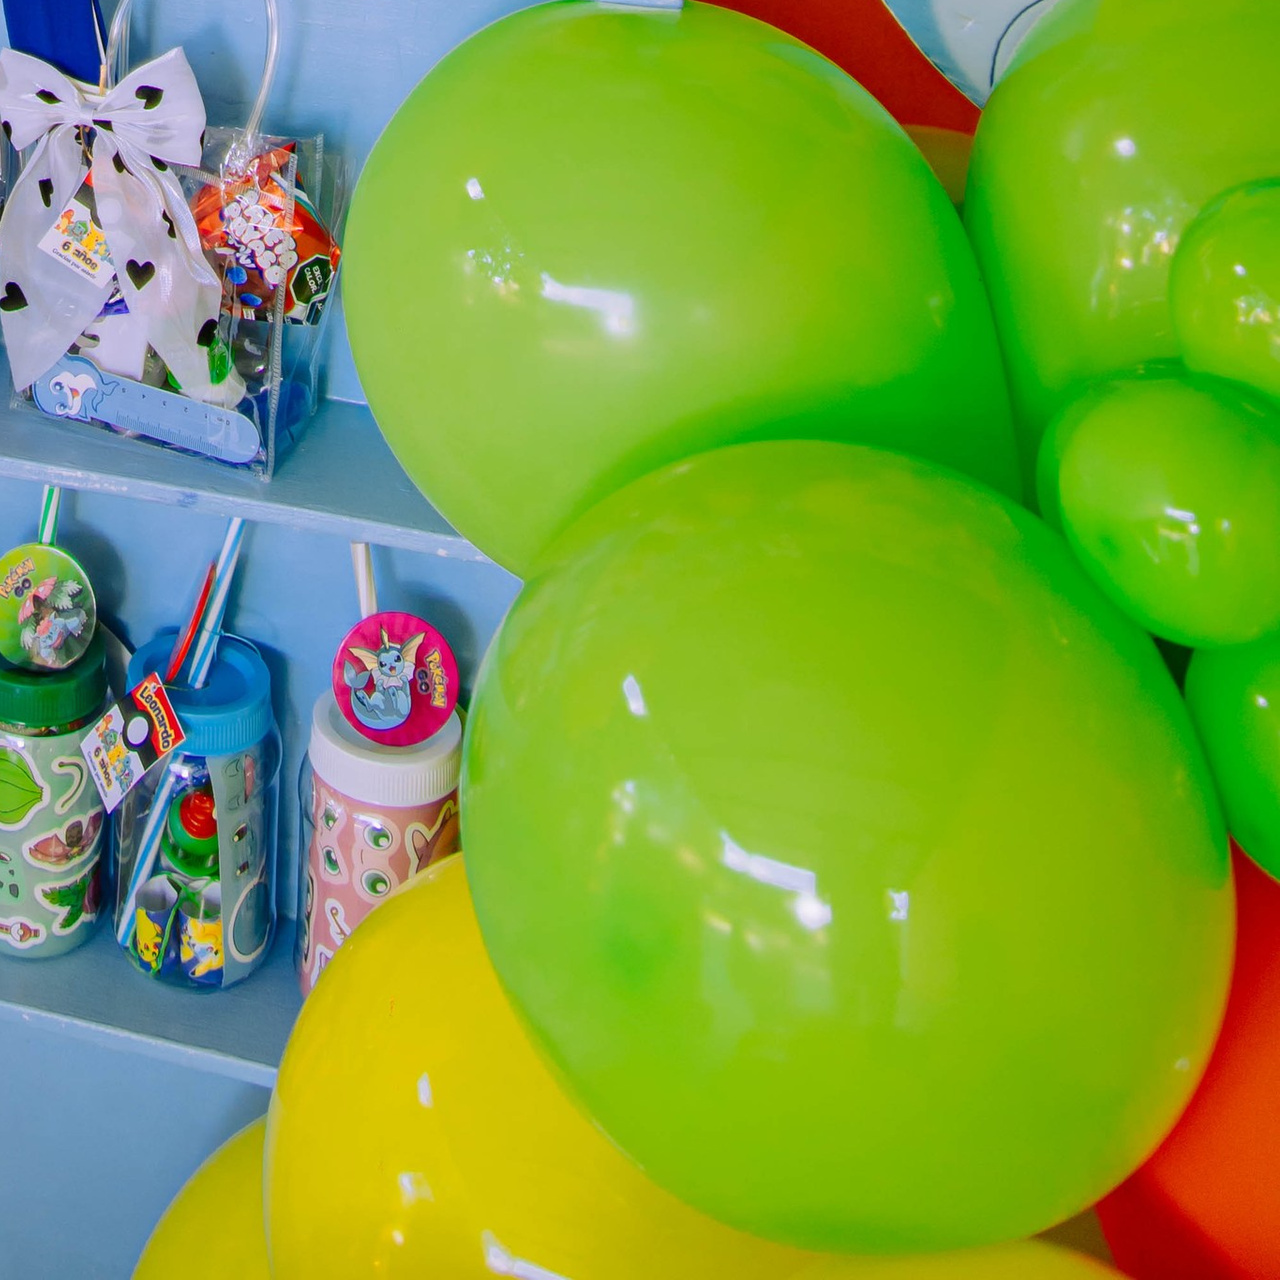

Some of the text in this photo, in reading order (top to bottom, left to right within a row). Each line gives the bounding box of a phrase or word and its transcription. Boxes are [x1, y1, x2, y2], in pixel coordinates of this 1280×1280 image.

[62, 241, 98, 270] 6 años
[139, 686, 173, 749] Leonardo
